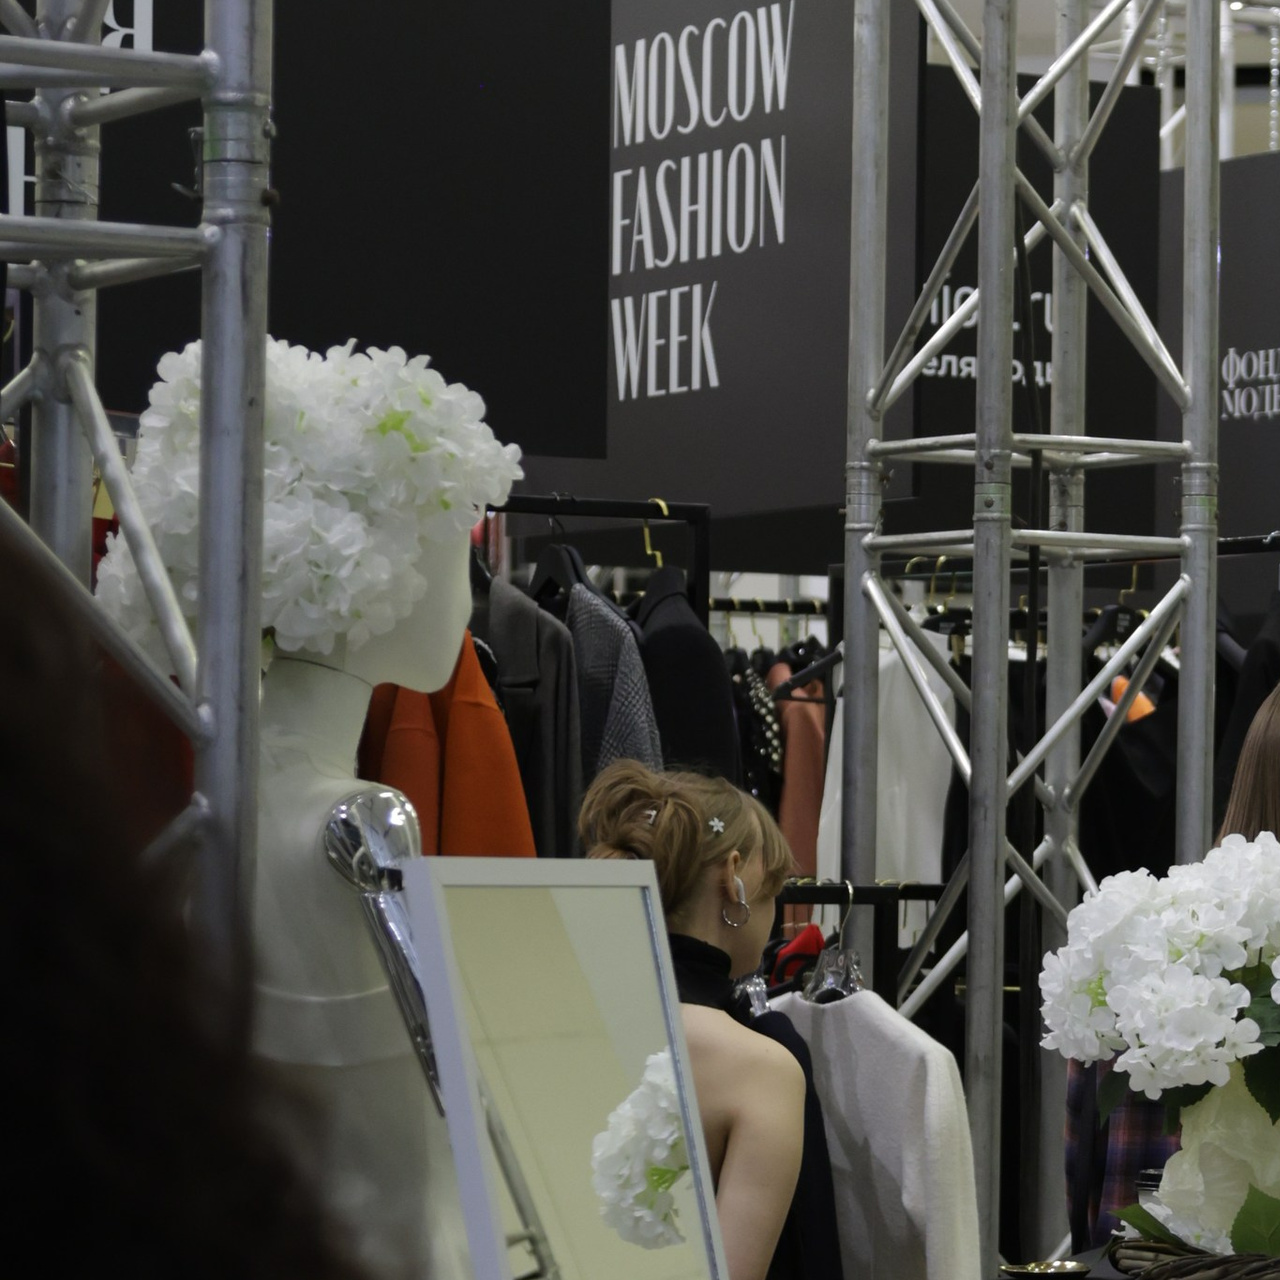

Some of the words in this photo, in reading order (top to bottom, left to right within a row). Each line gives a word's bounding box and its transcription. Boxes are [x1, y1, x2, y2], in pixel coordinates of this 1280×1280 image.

[612, 0, 796, 149] MOSCOW
[611, 135, 787, 276] FASHION
[610, 281, 720, 401] WEEK
